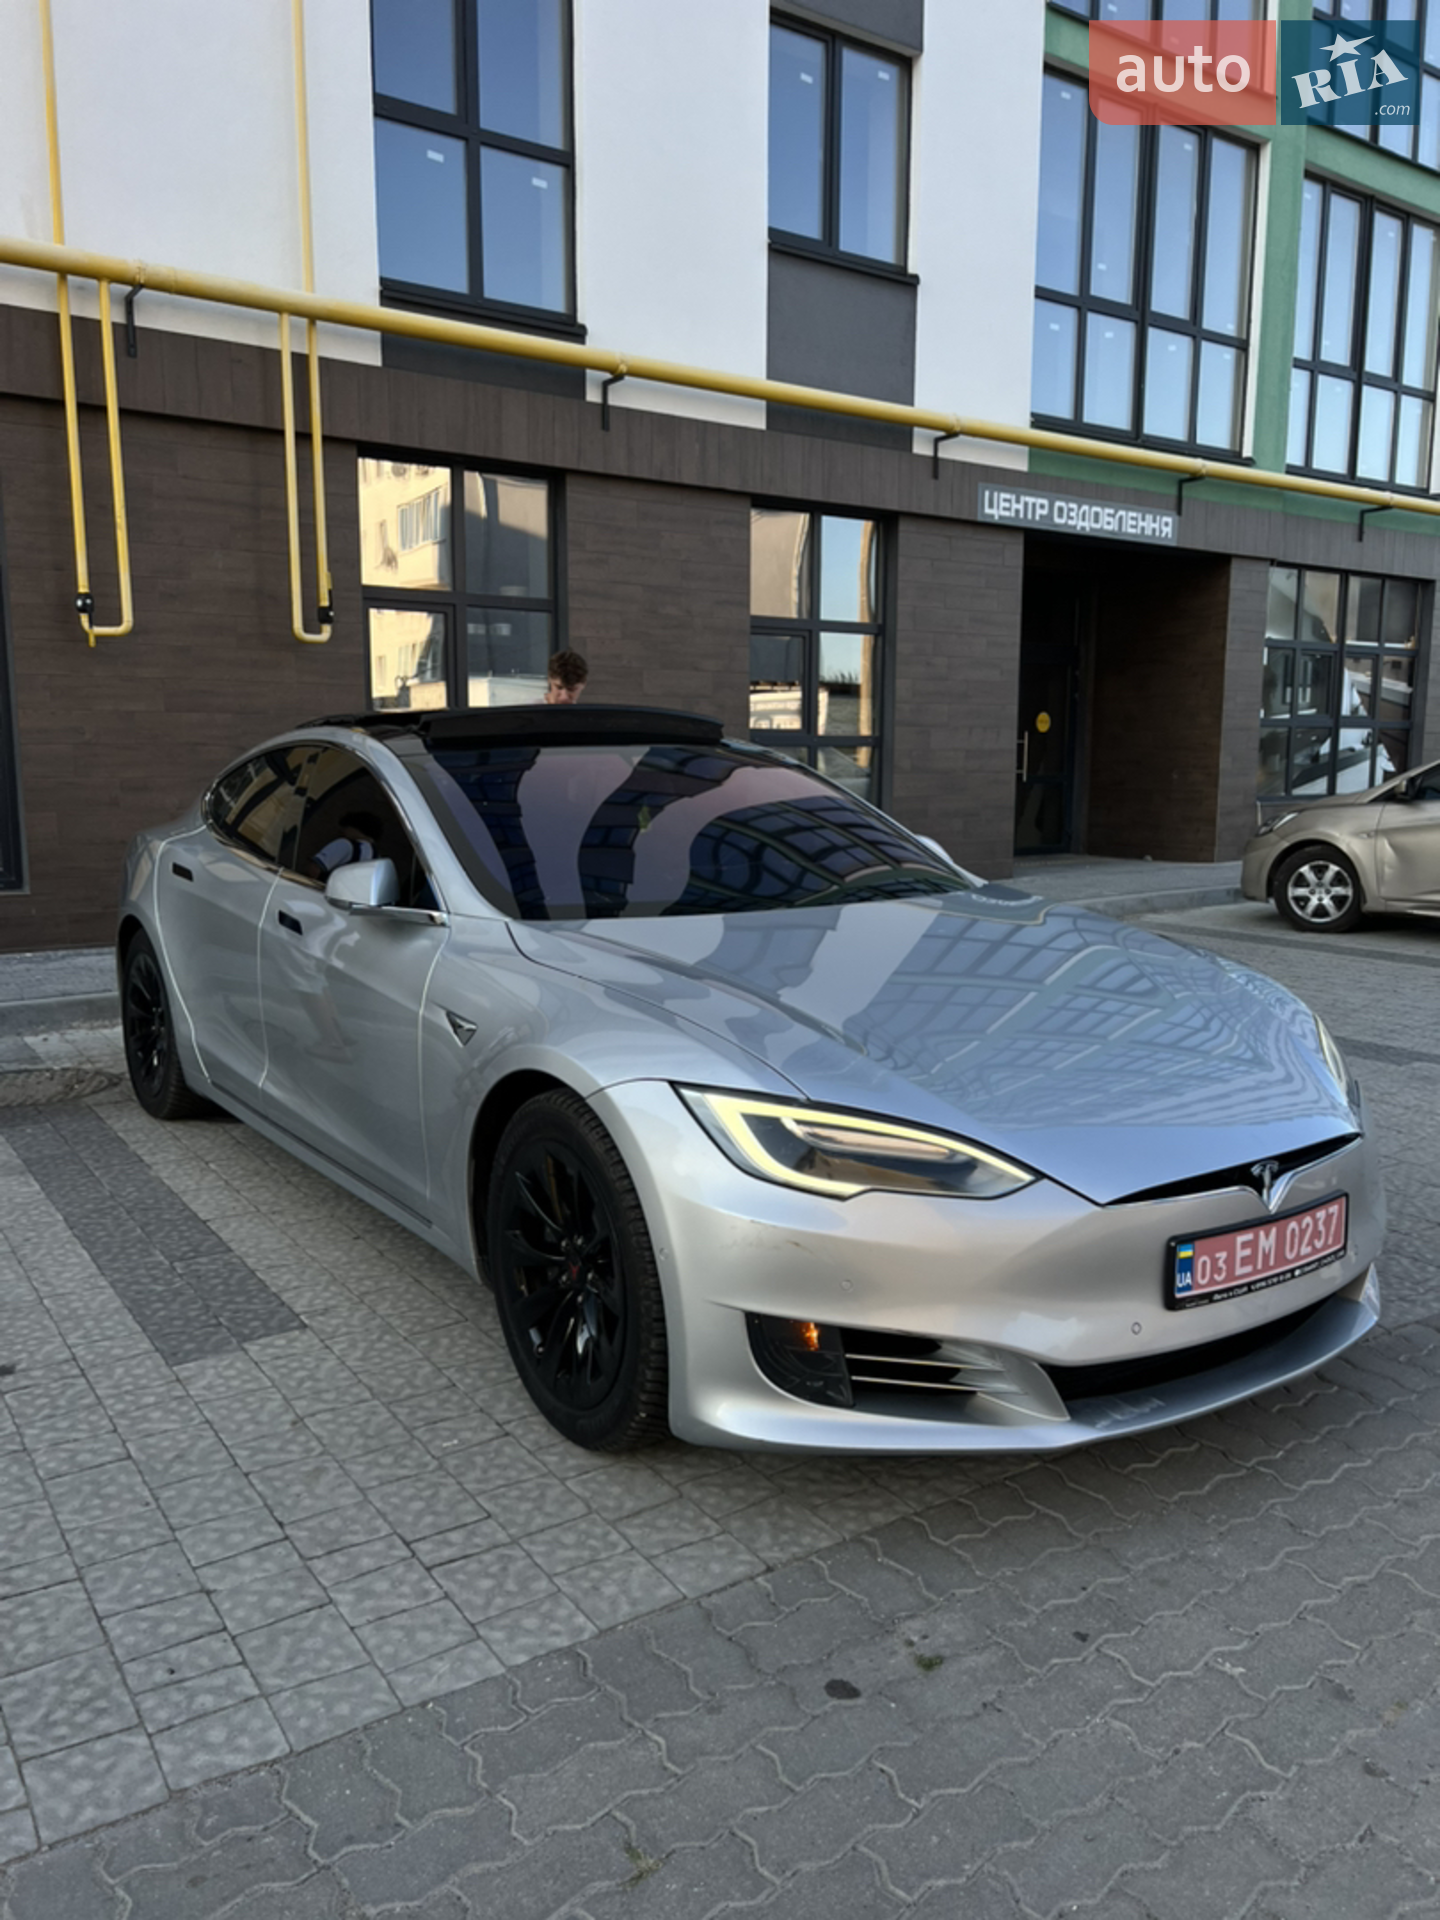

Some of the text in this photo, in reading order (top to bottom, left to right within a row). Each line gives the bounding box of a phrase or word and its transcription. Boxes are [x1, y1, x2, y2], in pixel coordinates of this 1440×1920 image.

[983, 489, 1173, 539] ЦЕНТР ОЗДОБЛЕННЯ
[1197, 1250, 1227, 1285] 03
[1234, 1226, 1277, 1277] EM
[1284, 1204, 1339, 1261] 0237
[1176, 1272, 1192, 1288] UA
